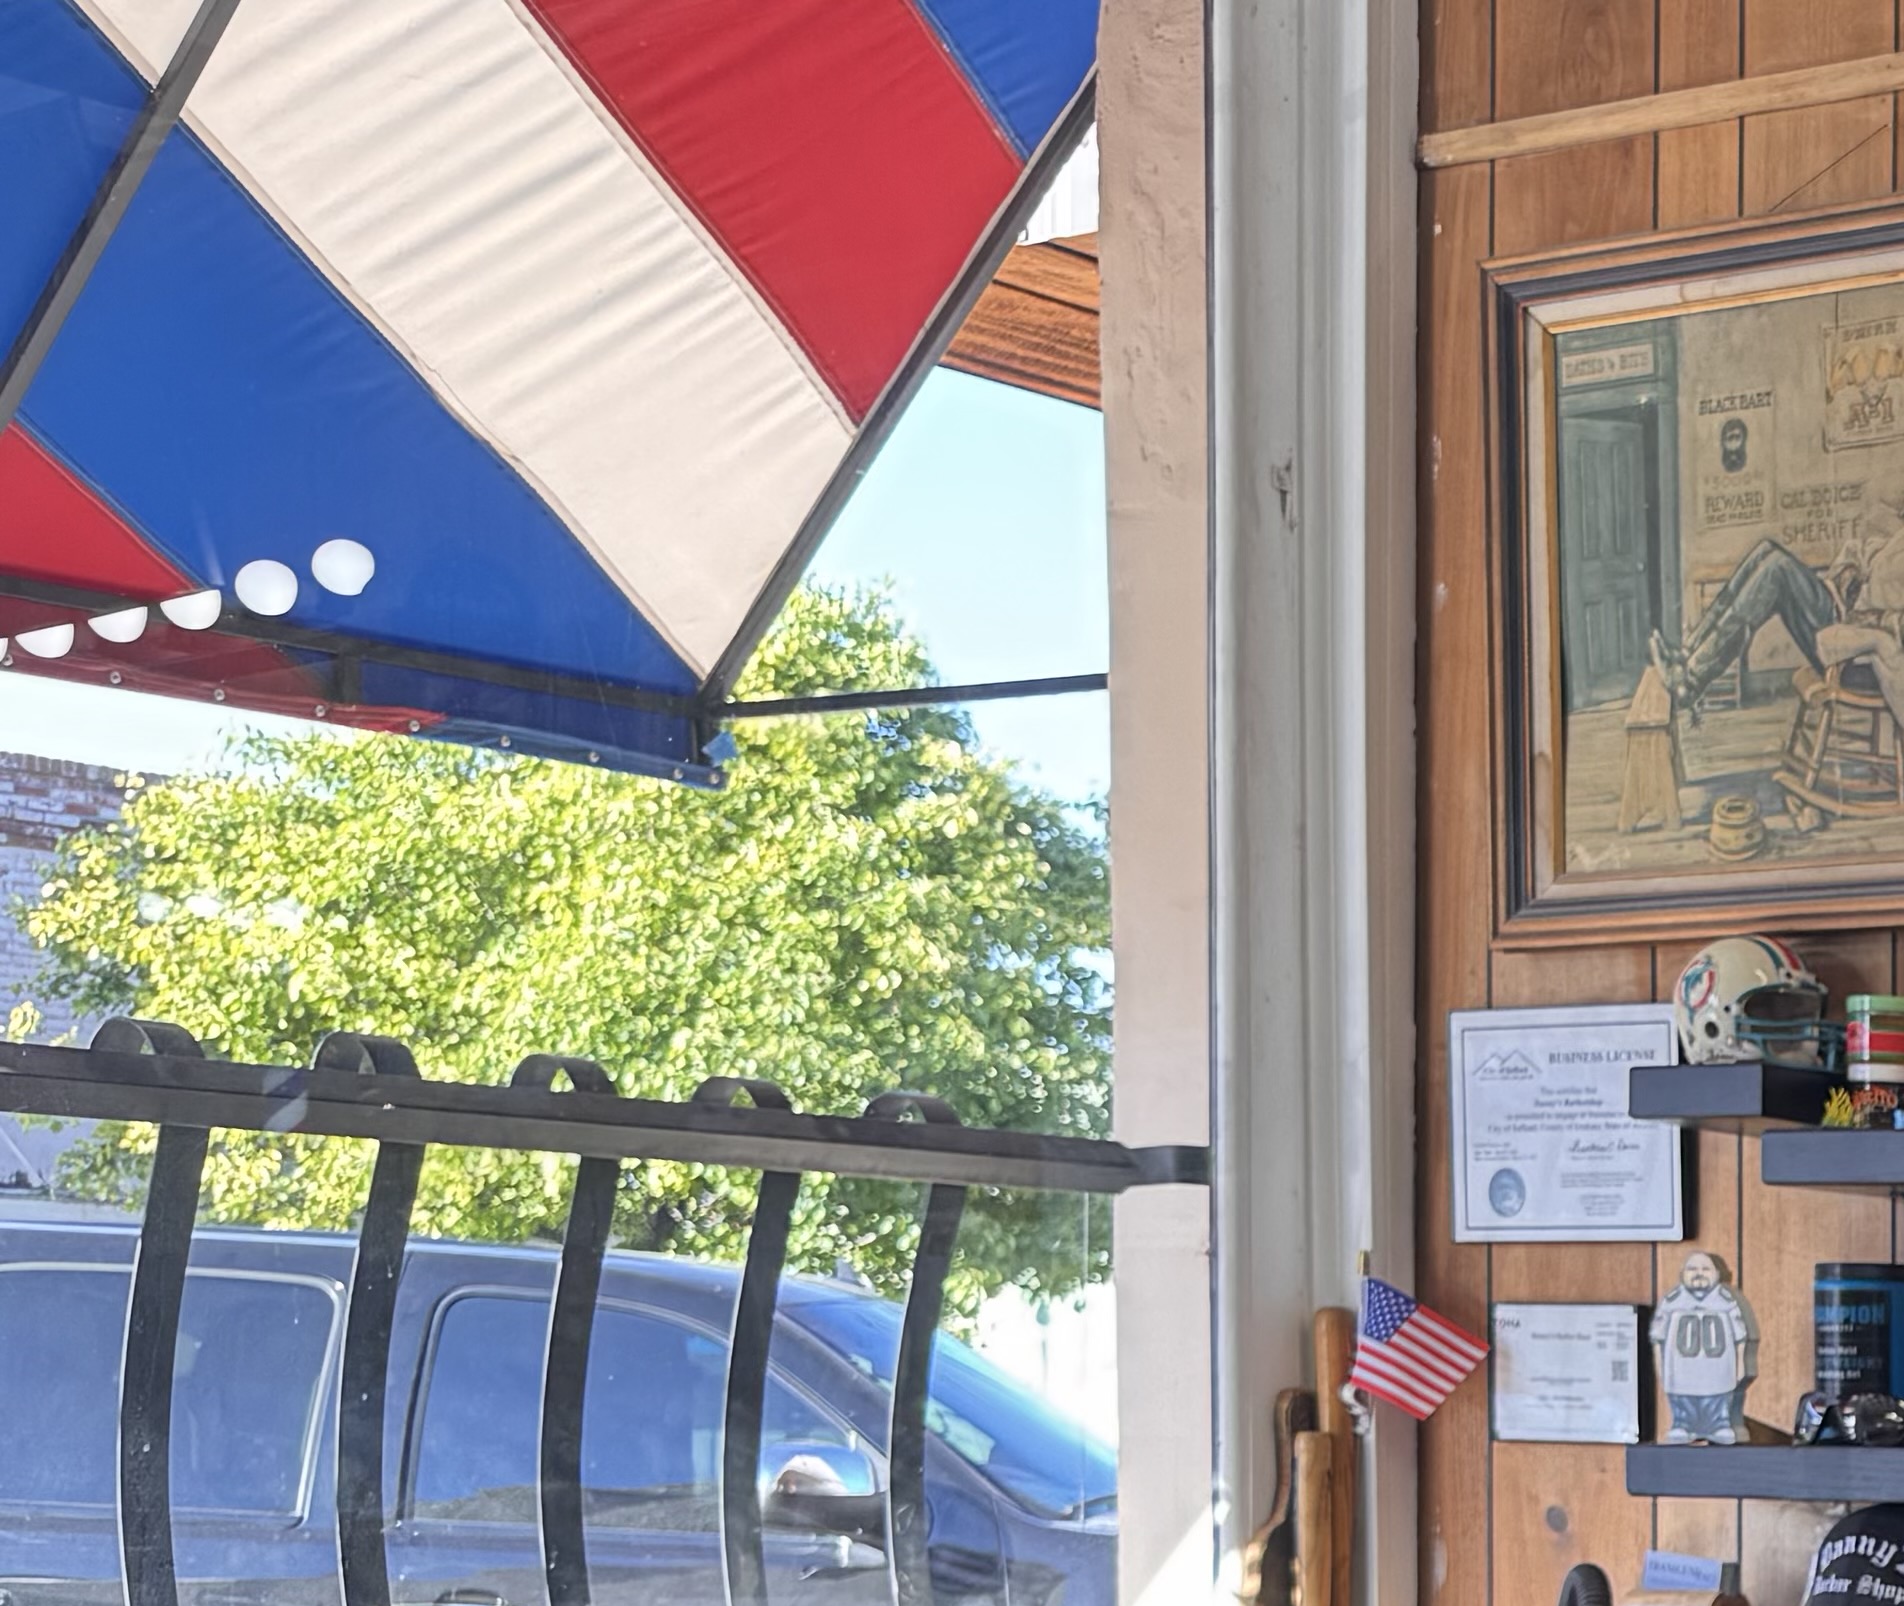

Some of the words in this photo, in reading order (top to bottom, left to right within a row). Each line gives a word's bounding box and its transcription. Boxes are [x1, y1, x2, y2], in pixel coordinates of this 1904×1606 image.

[1781, 514, 1864, 545] SHERIFF
[1548, 1050, 1604, 1065] BUSINESS
[1606, 1048, 1656, 1062] LICENSE
[1676, 1314, 1726, 1358] 00
